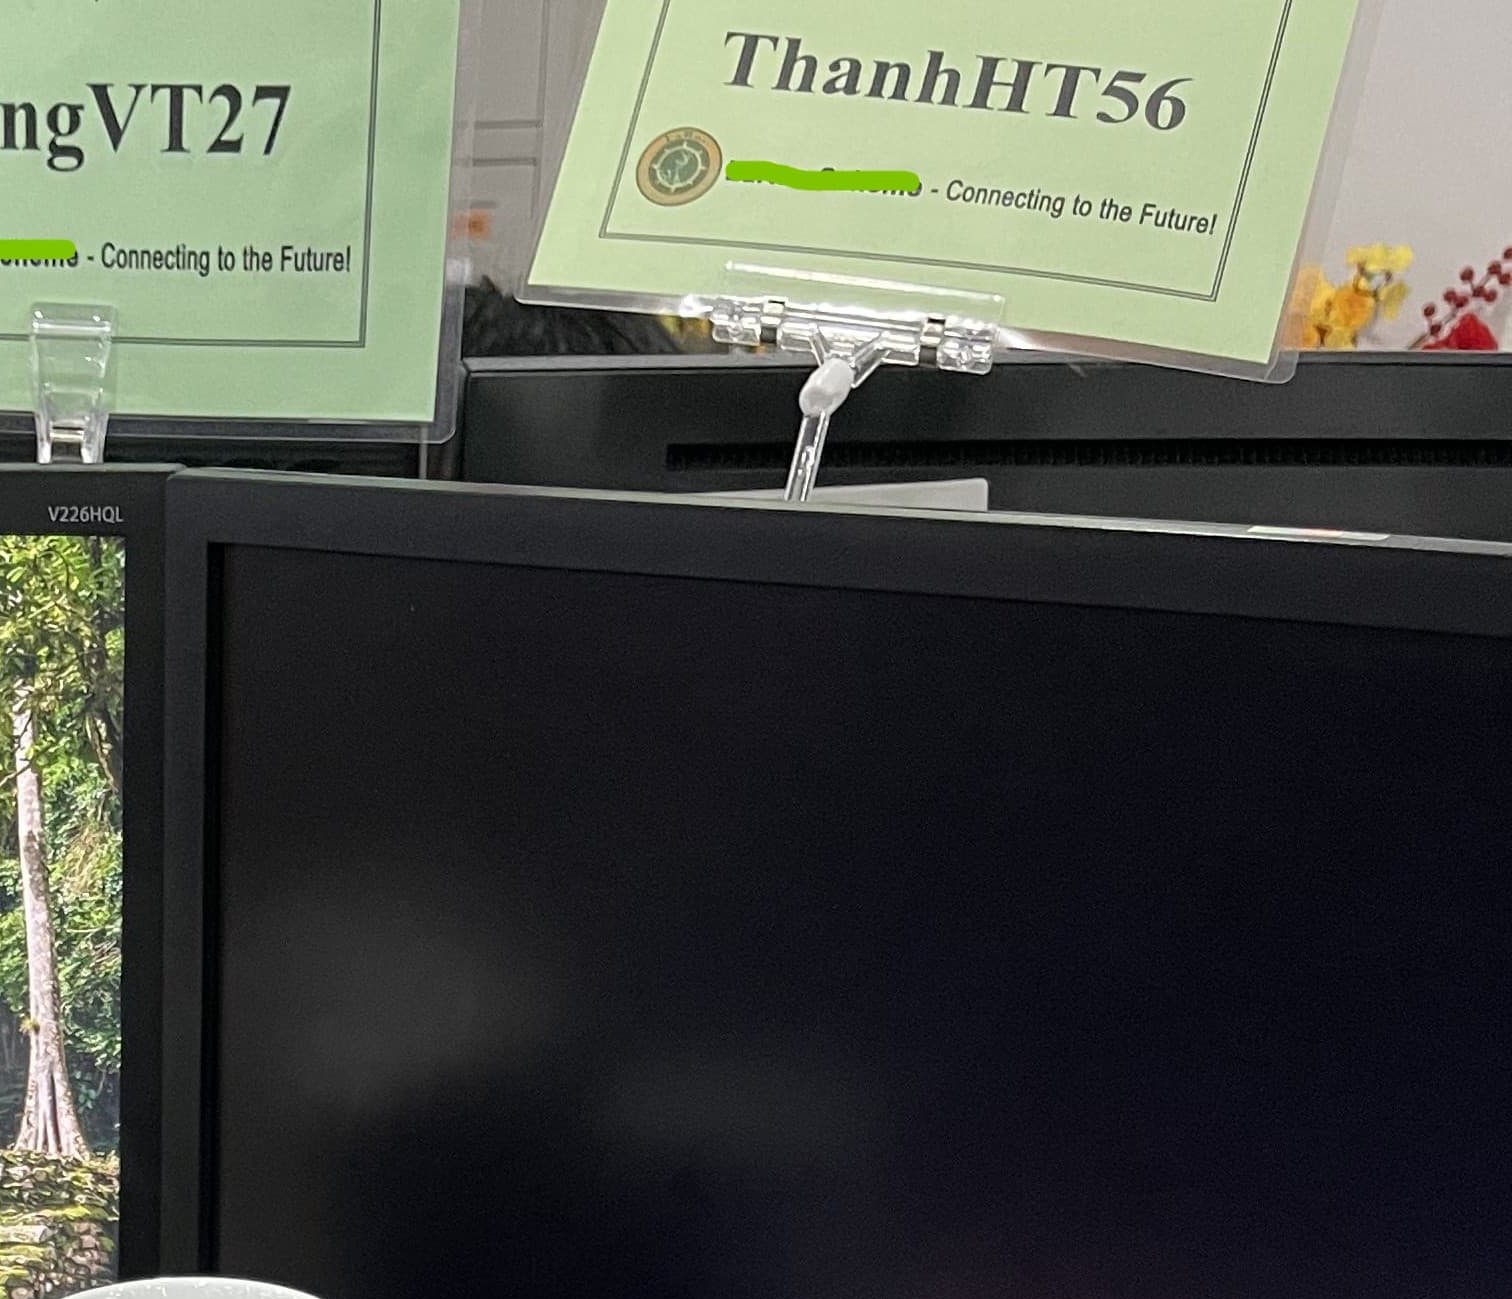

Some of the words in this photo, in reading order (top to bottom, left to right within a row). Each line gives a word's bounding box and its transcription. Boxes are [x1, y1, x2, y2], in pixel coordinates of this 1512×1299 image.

[724, 31, 1195, 131] ThanhHT56
[946, 180, 1065, 219] Connecting
[1073, 192, 1092, 218] to
[1098, 196, 1132, 224] the
[1139, 202, 1218, 236] Future!
[101, 242, 210, 275] Connecting
[218, 246, 236, 271] to
[241, 246, 275, 272] the
[280, 246, 351, 273] Future!
[48, 506, 124, 524] V226HQL
